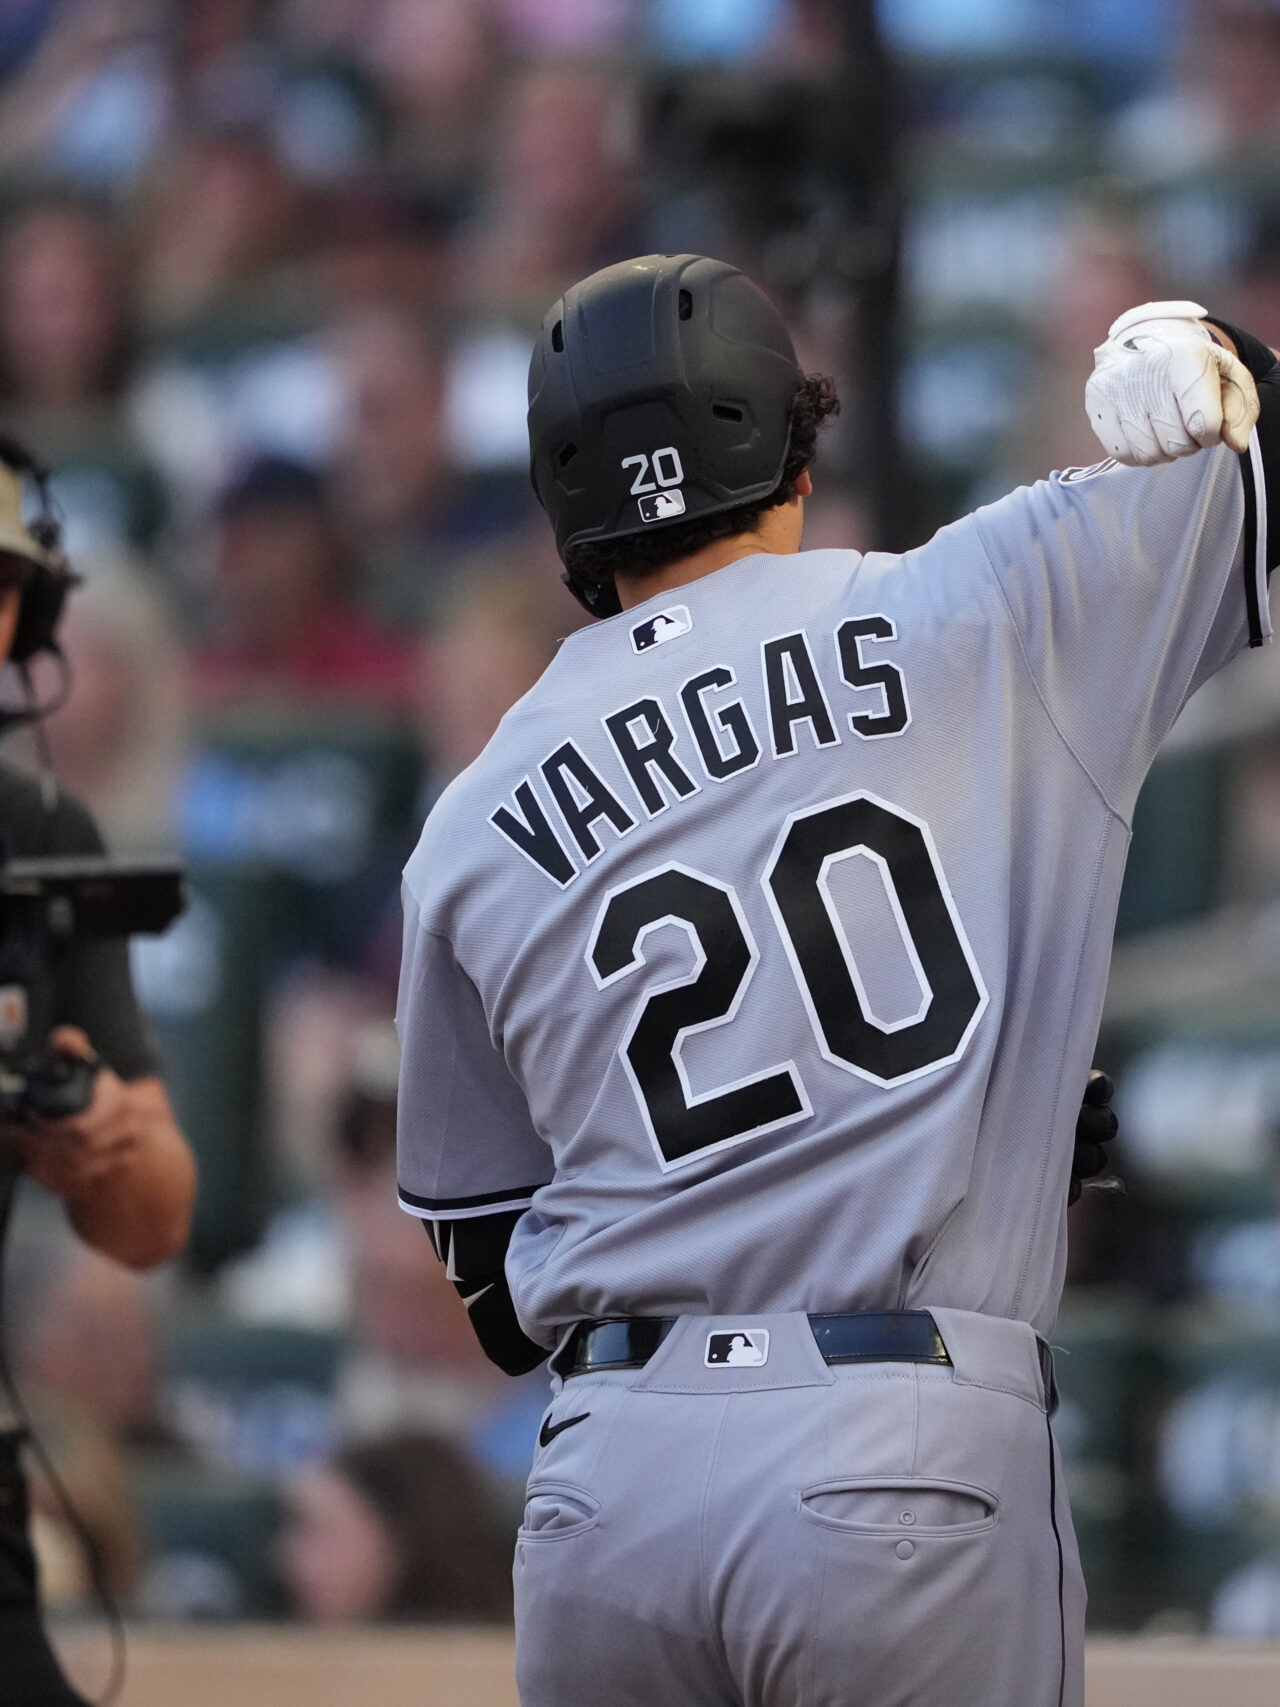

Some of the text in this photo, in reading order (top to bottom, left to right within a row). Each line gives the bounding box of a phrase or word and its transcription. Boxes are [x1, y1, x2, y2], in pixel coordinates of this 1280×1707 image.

[621, 446, 684, 495] 20
[487, 613, 912, 890] VARGAS
[584, 789, 989, 1174] 20
